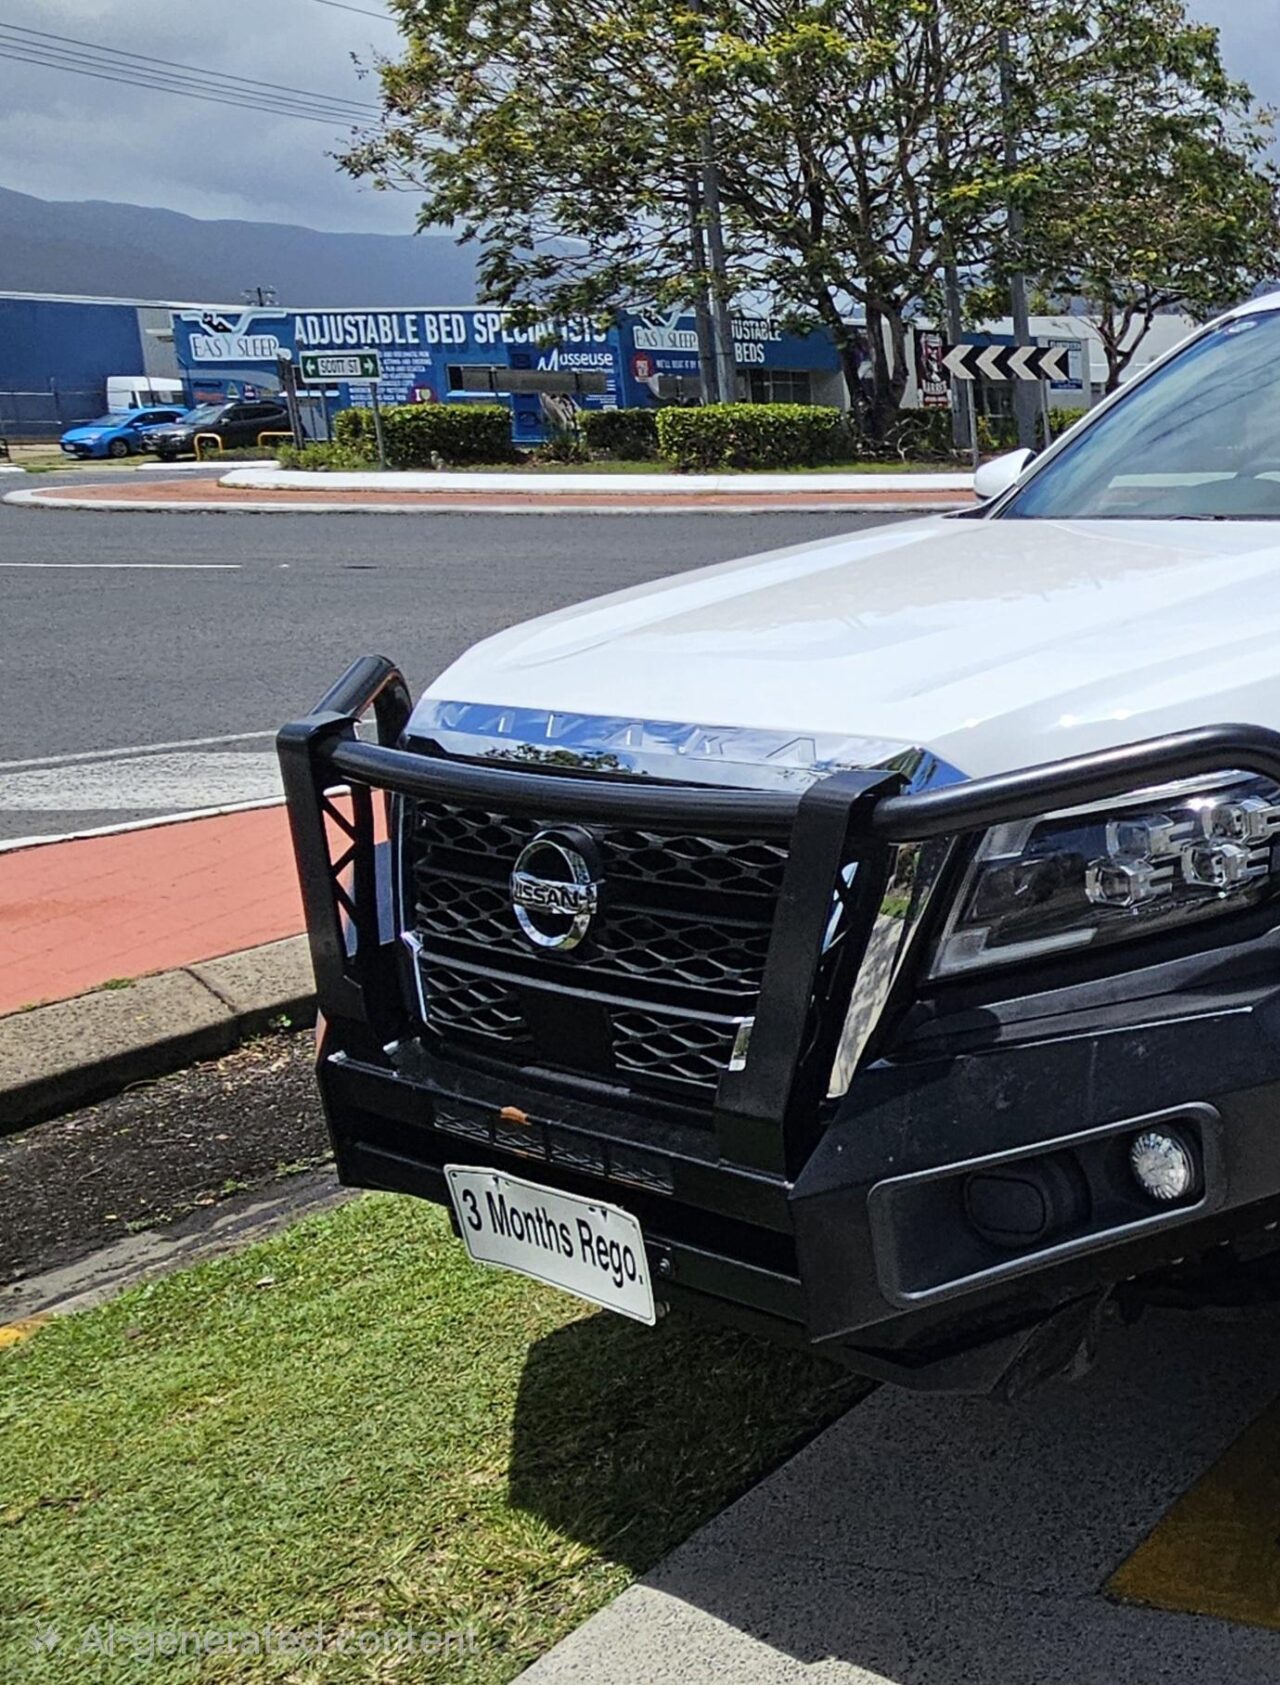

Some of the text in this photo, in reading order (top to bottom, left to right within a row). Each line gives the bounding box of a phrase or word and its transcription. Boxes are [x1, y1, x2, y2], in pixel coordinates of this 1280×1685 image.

[294, 314, 418, 345] ADJUSTABLE
[425, 313, 466, 344] BED
[193, 334, 279, 357] EASY SLEEP
[735, 342, 766, 363] BEDS
[320, 359, 360, 374] SCOTT ST
[537, 348, 614, 371] Masseuse
[462, 1188, 483, 1232] 3
[485, 1190, 574, 1258] Months
